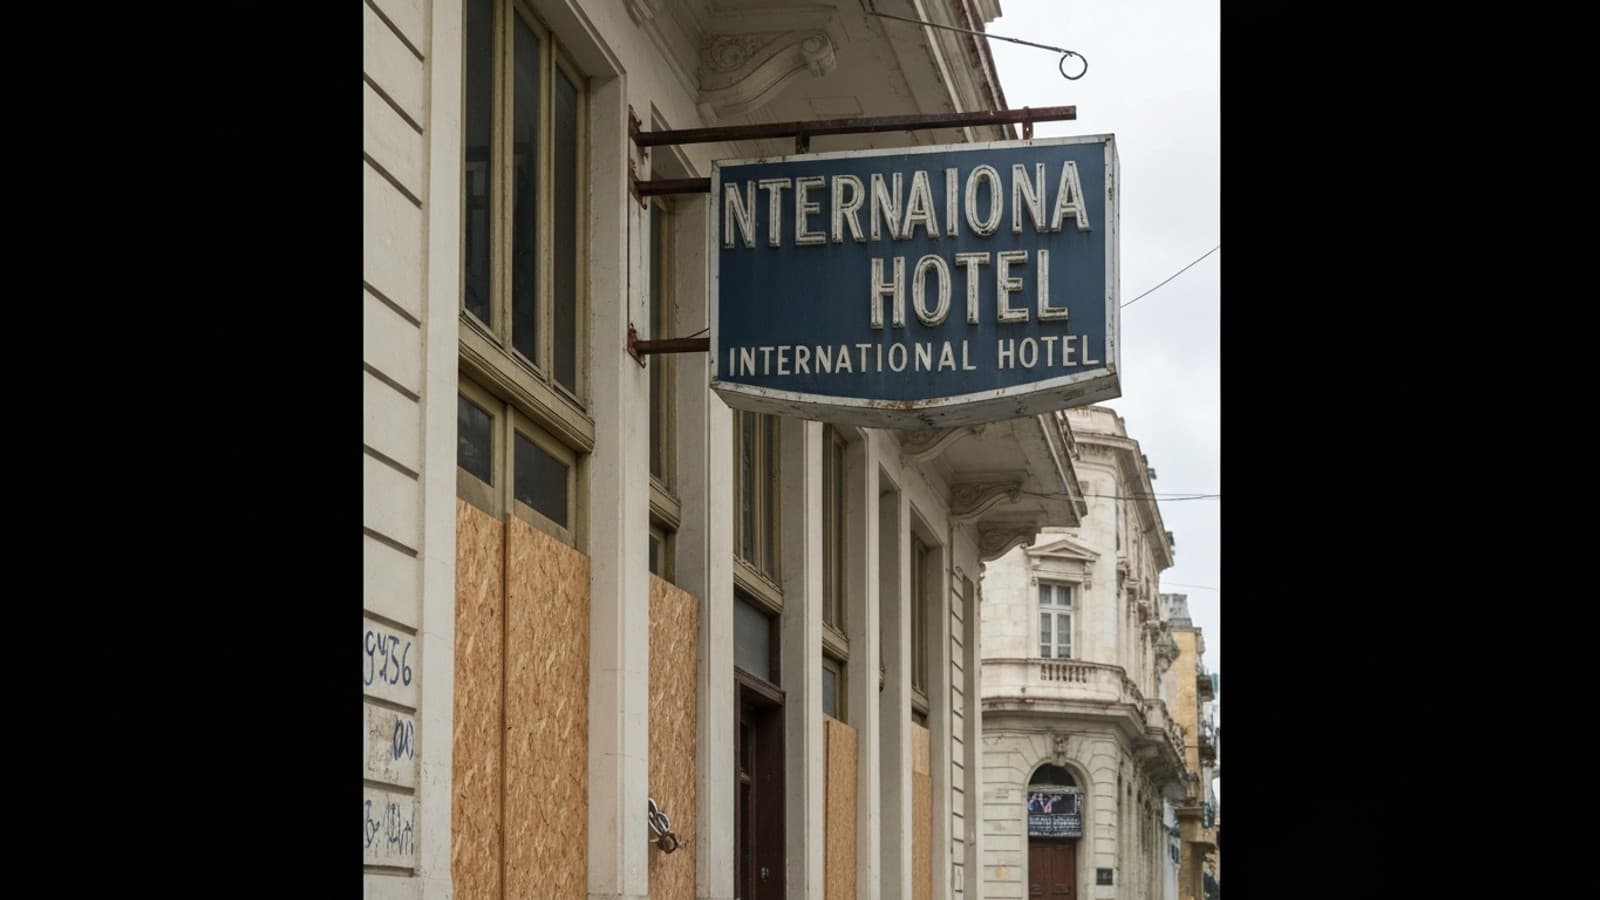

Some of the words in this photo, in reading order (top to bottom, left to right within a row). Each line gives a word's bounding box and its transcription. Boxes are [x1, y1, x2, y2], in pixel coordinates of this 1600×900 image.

[724, 161, 1092, 249] NTERNAIONA
[870, 249, 1069, 329] HOTEL
[729, 340, 977, 376] INTERNATIONAL
[998, 335, 1100, 368] HOTEL
